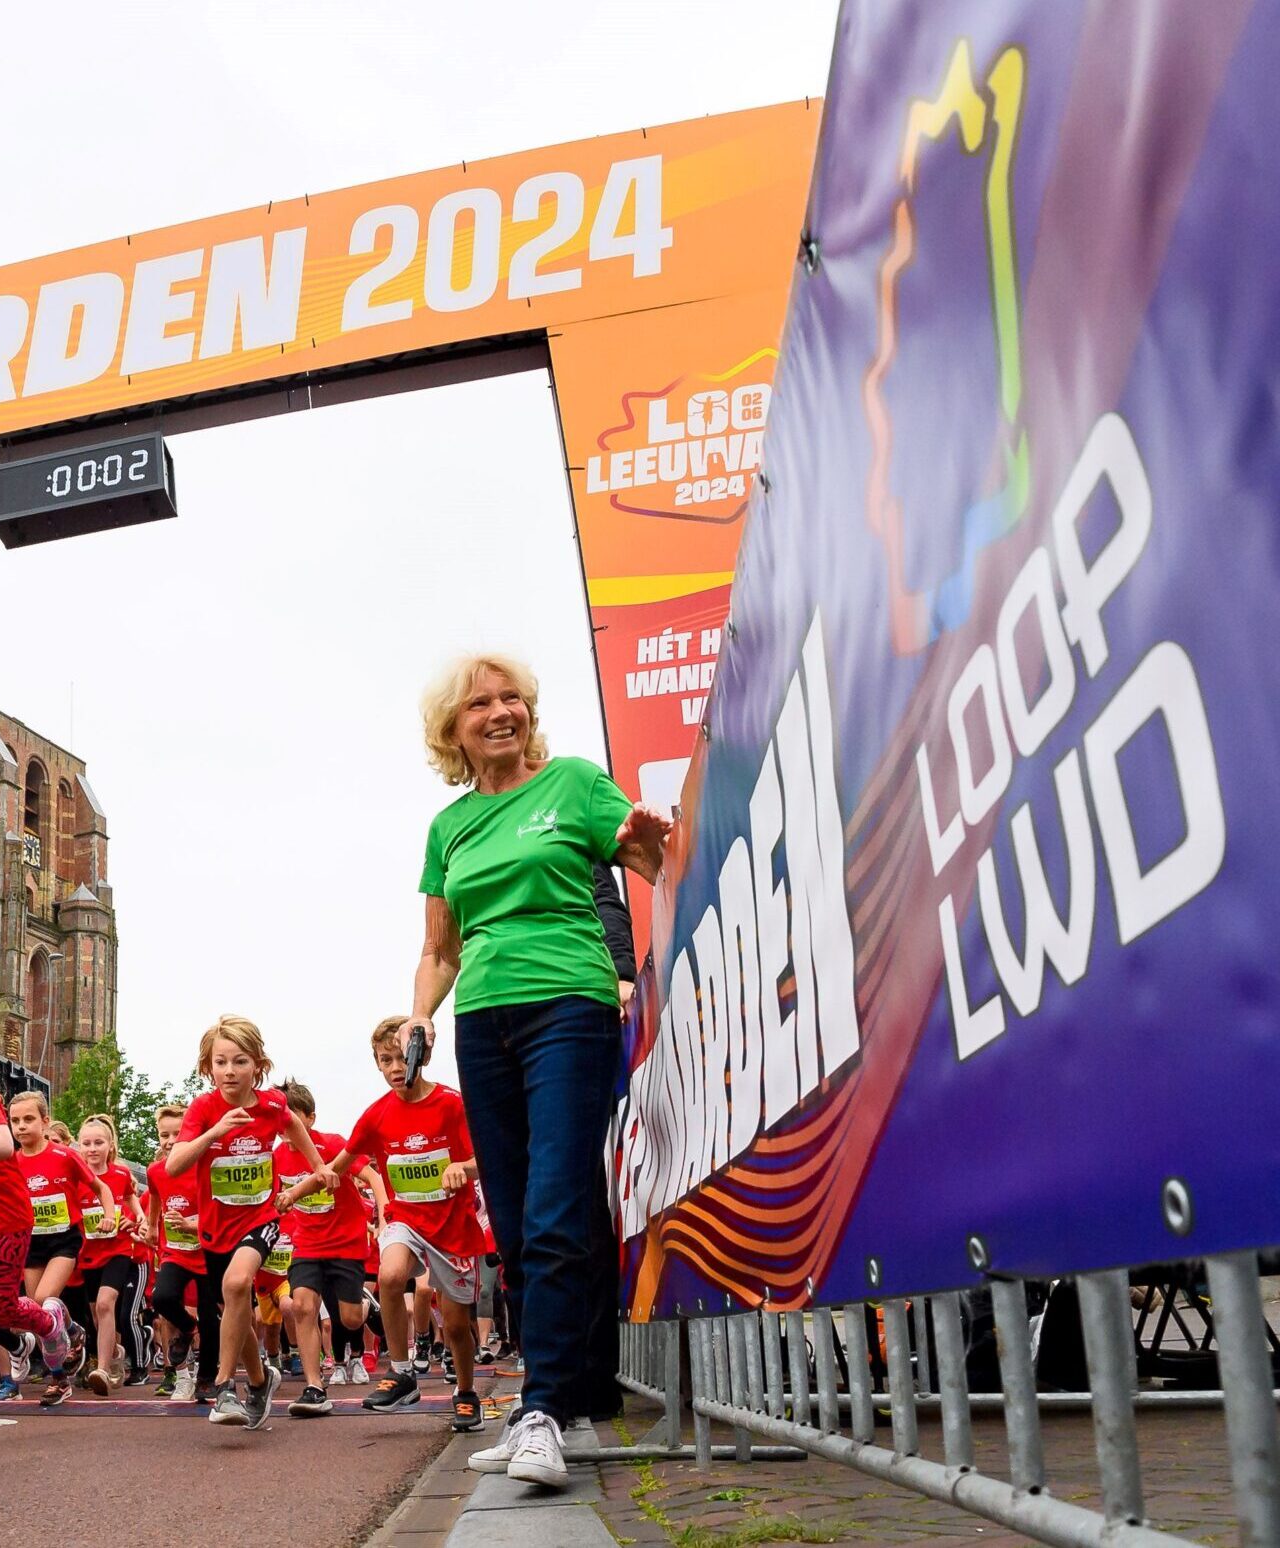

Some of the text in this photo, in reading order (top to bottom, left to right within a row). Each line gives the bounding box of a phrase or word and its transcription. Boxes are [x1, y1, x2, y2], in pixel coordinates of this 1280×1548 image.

[341, 155, 674, 332] 2024
[648, 383, 772, 444] LOO
[741, 392, 763, 407] 02
[586, 430, 765, 494] LEEUWA
[674, 473, 746, 506] 2024
[637, 627, 721, 665] HÉT H
[916, 411, 1154, 878] LOOP
[625, 662, 717, 699] WAND
[938, 640, 1227, 1063] LWD
[224, 1165, 264, 1182] 10281
[398, 1164, 439, 1181] 10806
[33, 1204, 58, 1217] 0468
[90, 1214, 106, 1225] 10
[270, 1252, 290, 1262] 0469
